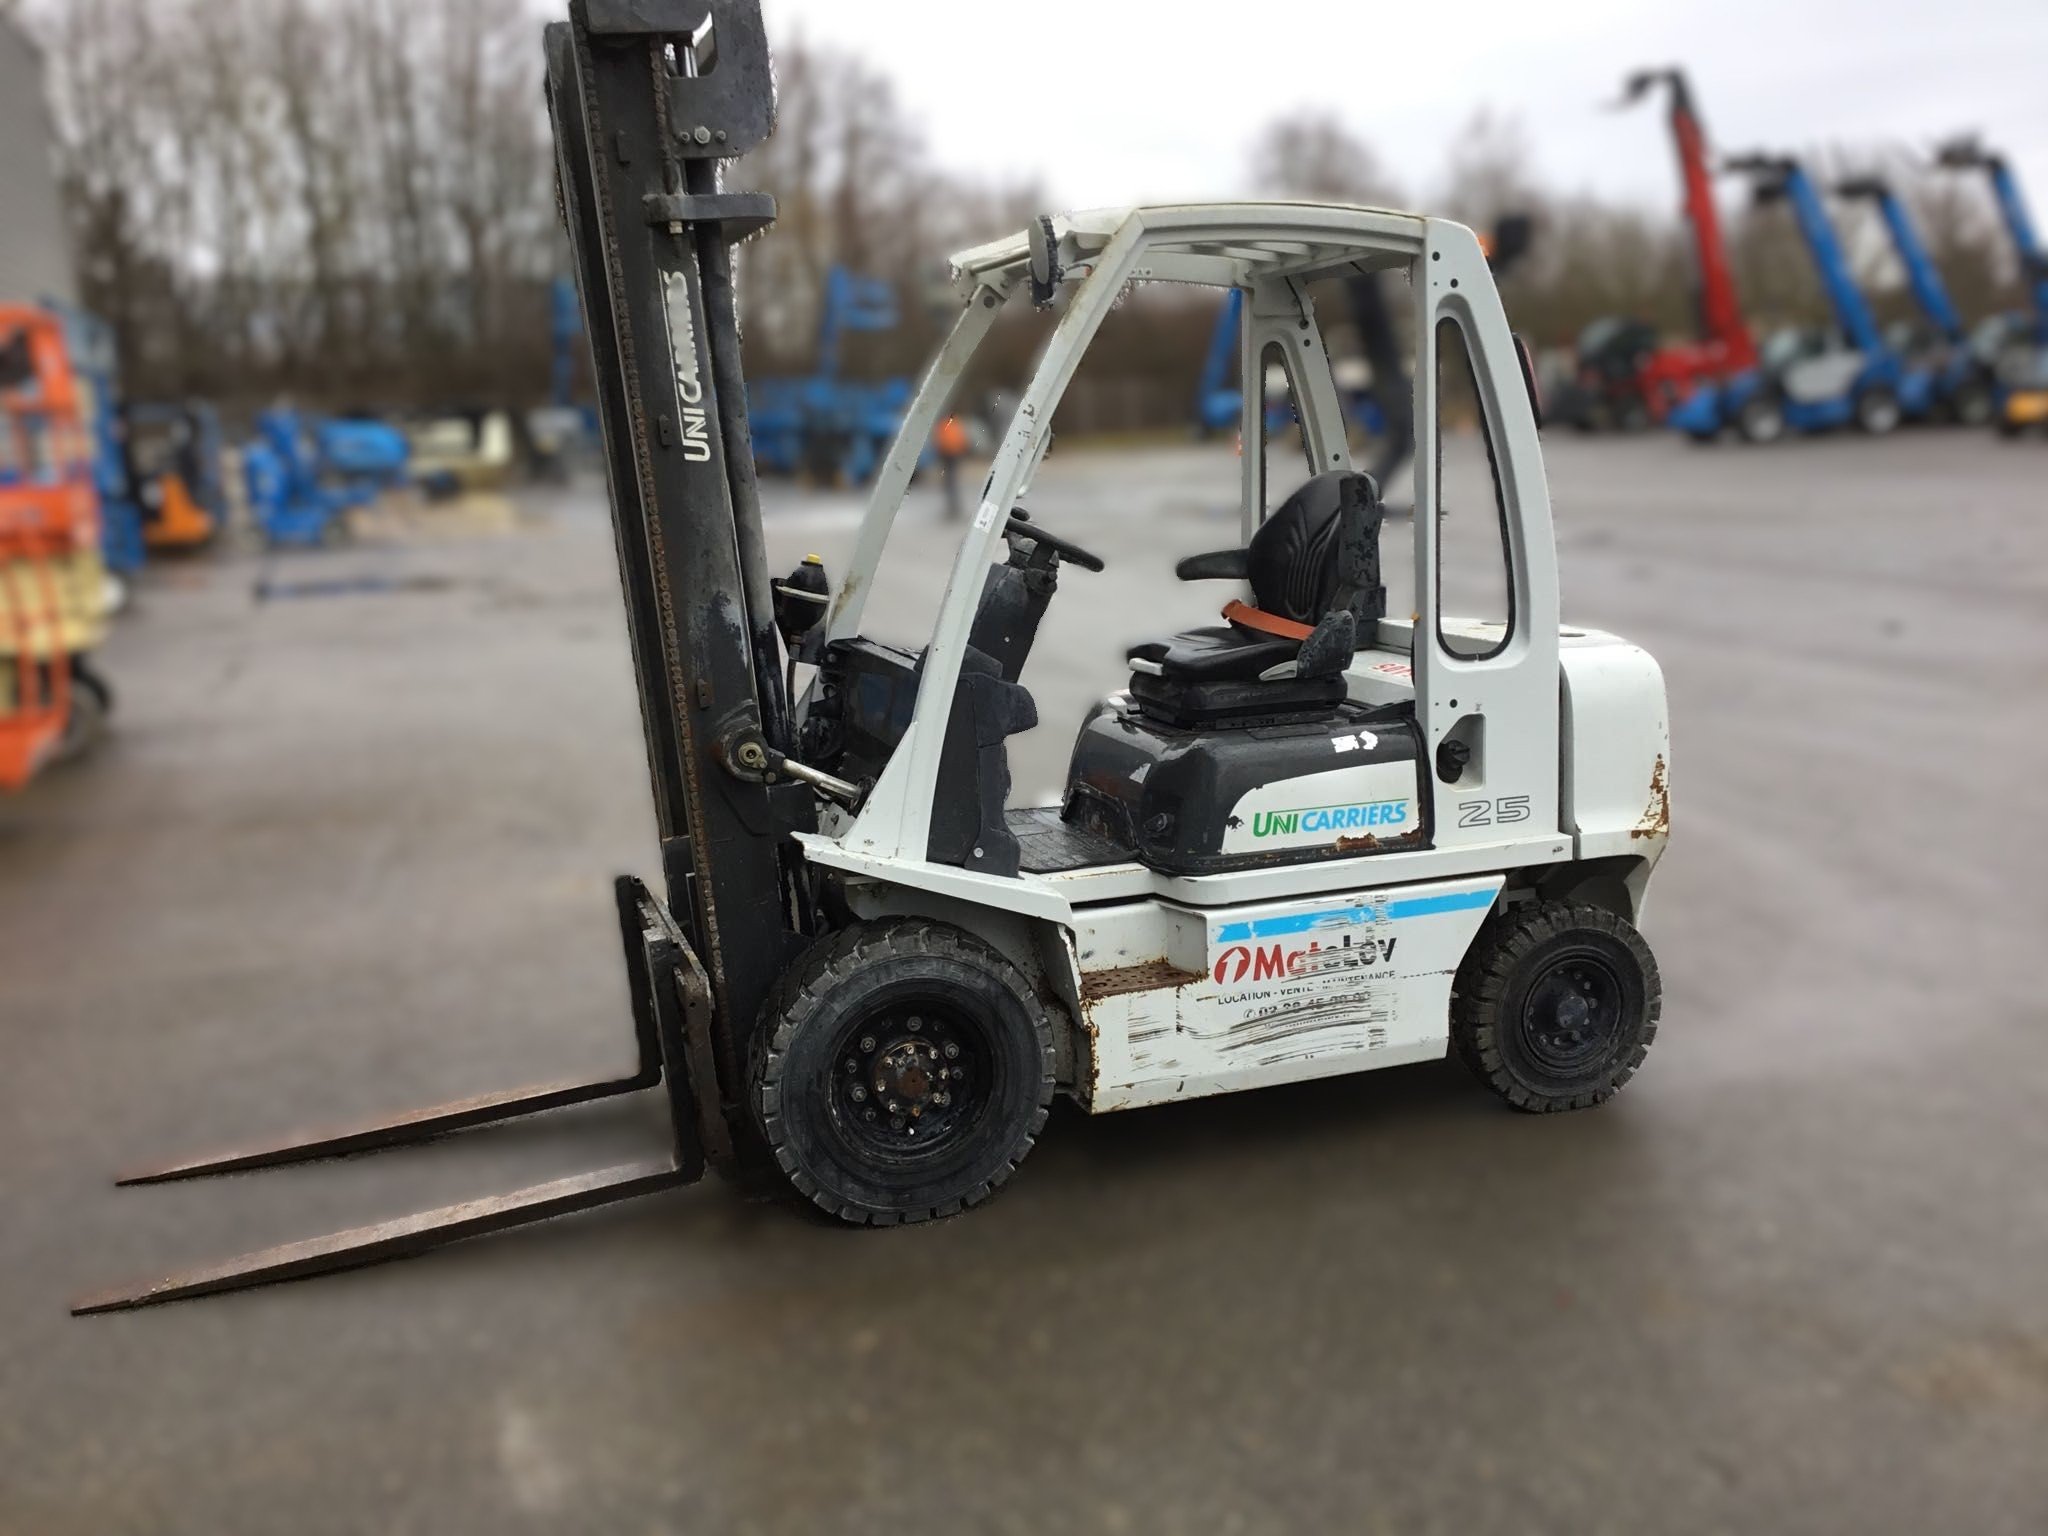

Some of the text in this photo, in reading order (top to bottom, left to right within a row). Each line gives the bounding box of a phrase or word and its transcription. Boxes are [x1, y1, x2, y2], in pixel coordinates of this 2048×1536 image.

[662, 270, 711, 462] UNICAS
[1253, 802, 1408, 838] UNICARRIERS
[1458, 795, 1531, 829] 25
